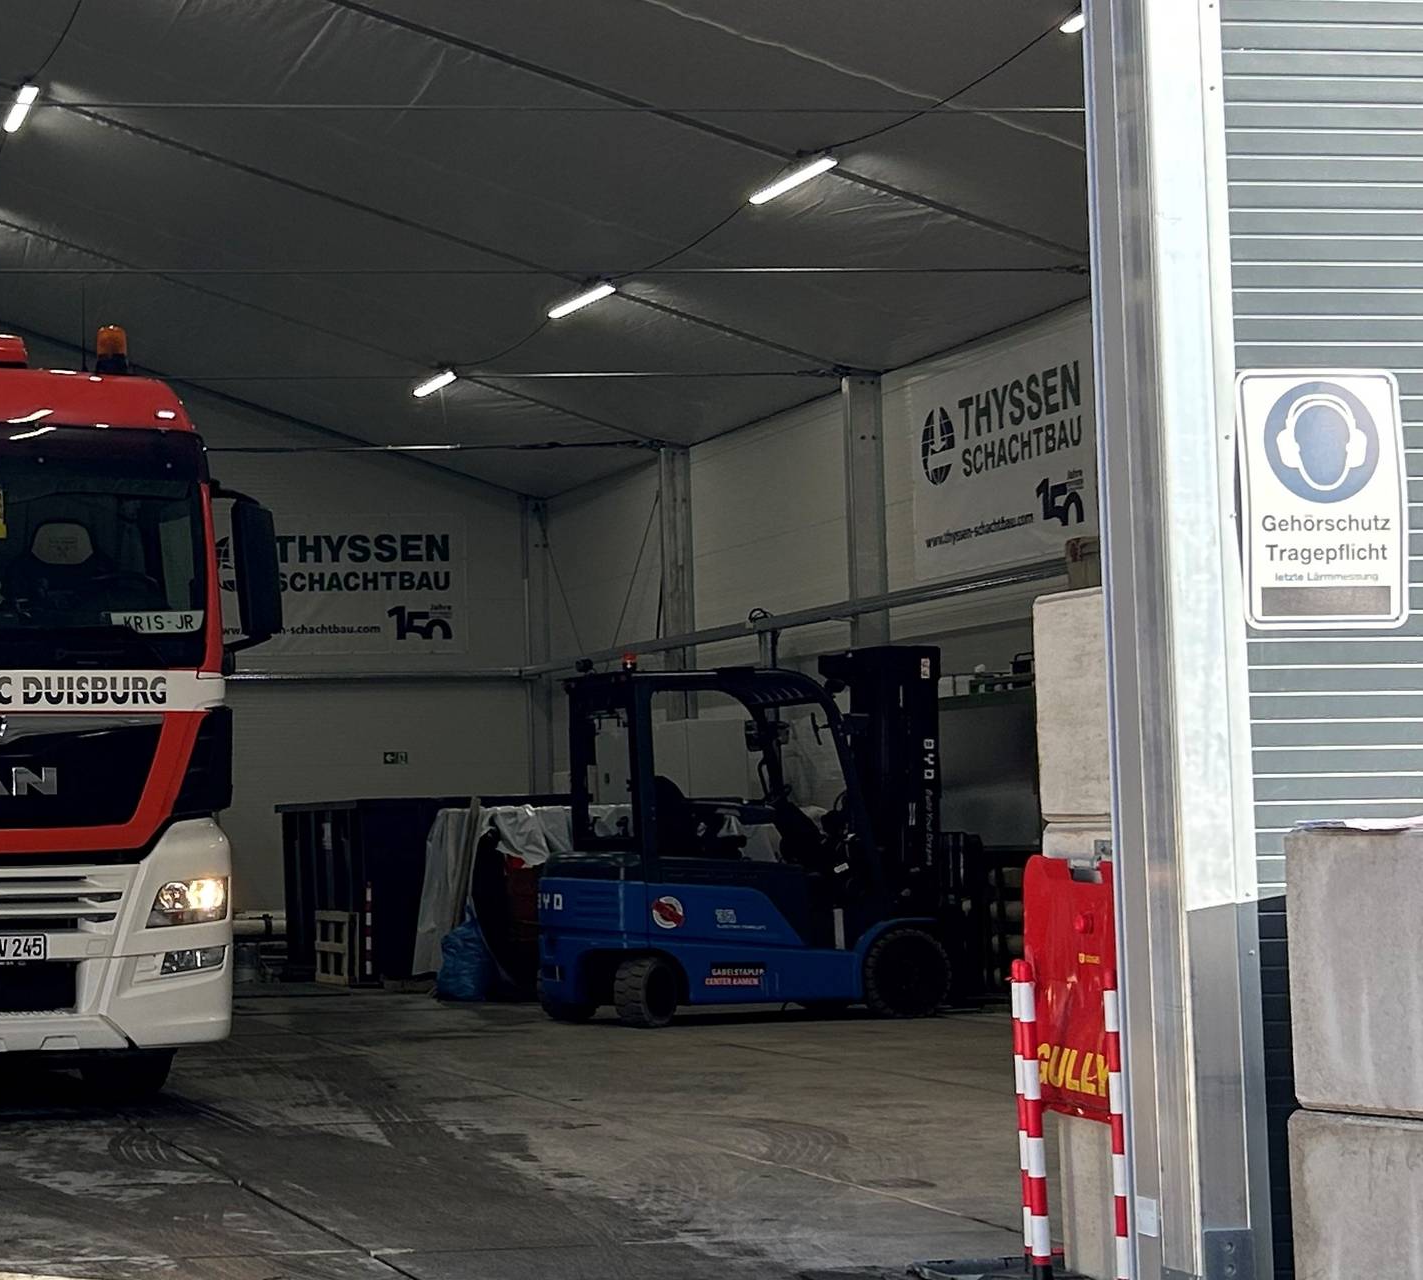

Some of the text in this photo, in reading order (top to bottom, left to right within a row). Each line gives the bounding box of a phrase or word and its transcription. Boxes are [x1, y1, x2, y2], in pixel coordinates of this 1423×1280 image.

[958, 360, 1081, 440] THYSSEN
[962, 415, 1082, 477] SCHACHTBAU
[1262, 514, 1391, 532] Gehörschutz
[275, 534, 450, 562] THYSSEN
[1265, 543, 1387, 565] Tragepflicht
[279, 571, 450, 591] SCHACHTBAU
[1275, 573, 1304, 581] letzte
[387, 606, 452, 640] 150
[22, 675, 167, 705] DUISBURG
[12, 938, 42, 957] 245
[1037, 1043, 1109, 1097] GULLY
